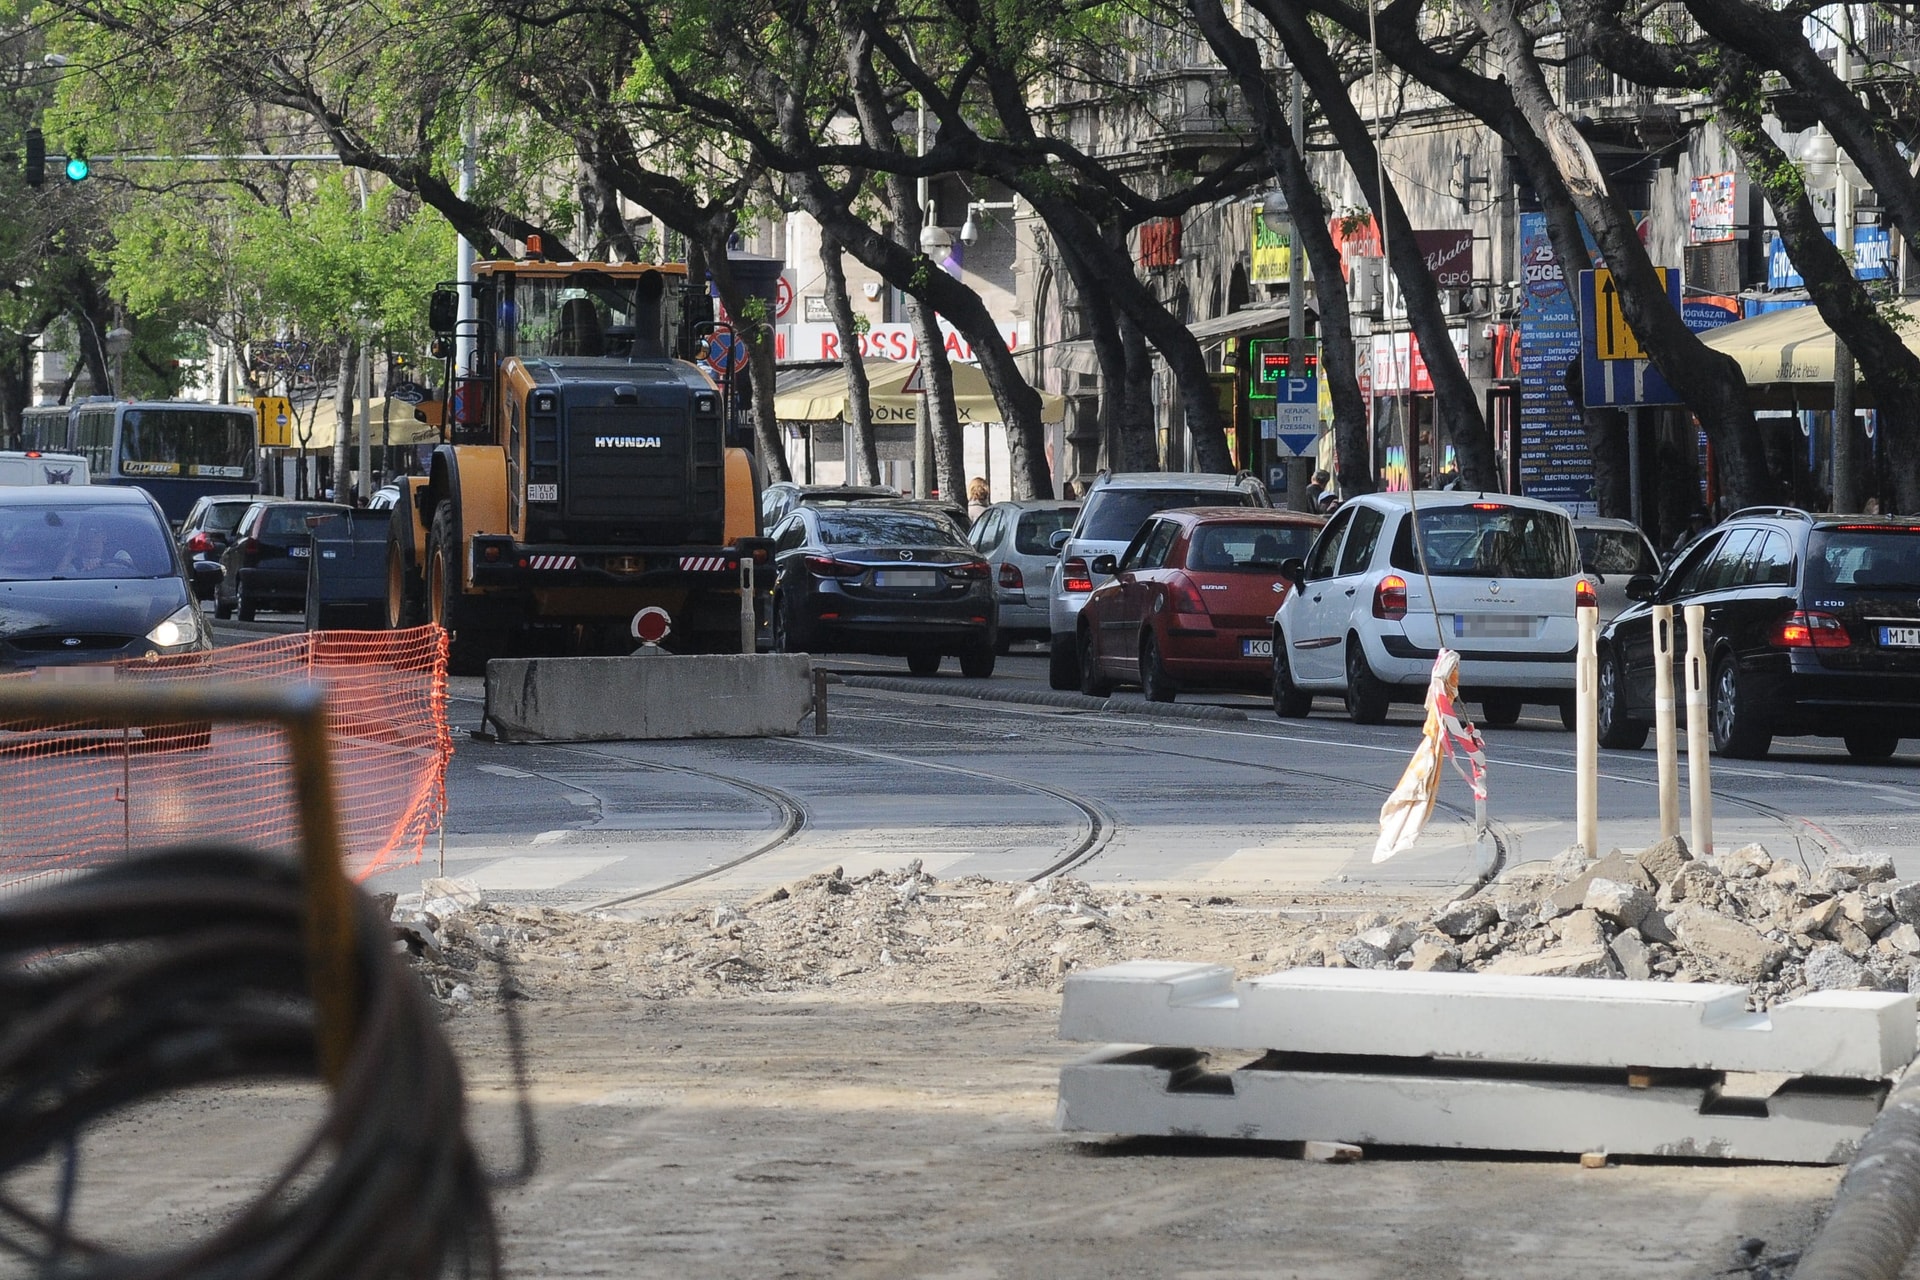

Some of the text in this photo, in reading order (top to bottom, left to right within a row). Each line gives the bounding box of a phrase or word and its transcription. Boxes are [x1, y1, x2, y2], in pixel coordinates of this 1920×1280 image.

[1536, 246, 1554, 262] 25
[1288, 379, 1307, 401] P
[595, 437, 661, 447] HYUNDAI
[208, 466, 225, 476] 4-6
[1270, 468, 1284, 486] P
[539, 484, 555, 492] YLK
[1889, 629, 1907, 644] MI
[1252, 641, 1271, 655] KO
